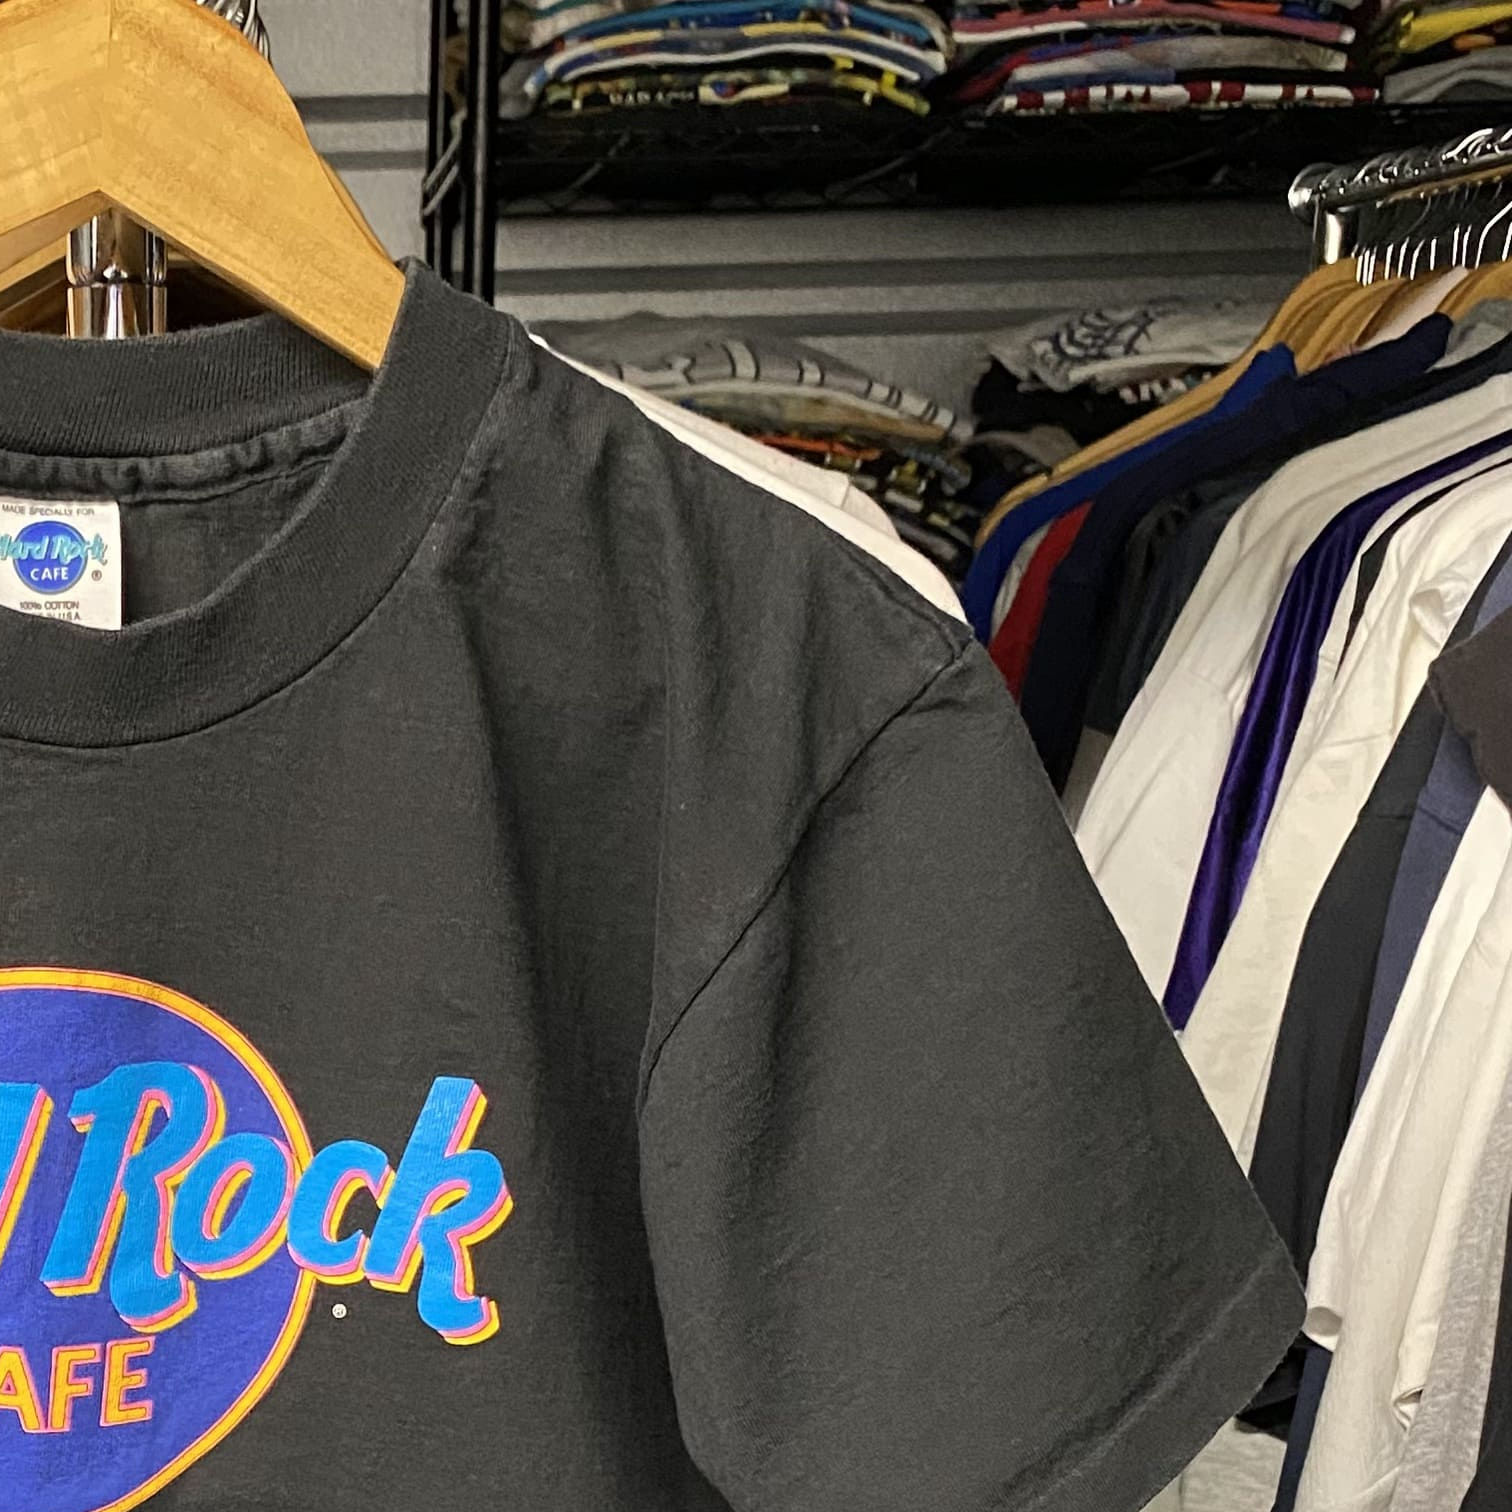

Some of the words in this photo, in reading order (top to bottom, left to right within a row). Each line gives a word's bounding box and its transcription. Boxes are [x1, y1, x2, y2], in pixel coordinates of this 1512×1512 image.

[2, 504, 26, 515] MADE
[29, 506, 74, 517] SPECIALLY
[76, 508, 95, 517] FOR
[50, 533, 109, 566] Rock
[29, 567, 69, 582] CAFE
[44, 601, 80, 611] COTTON
[41, 1060, 513, 1347] Rock
